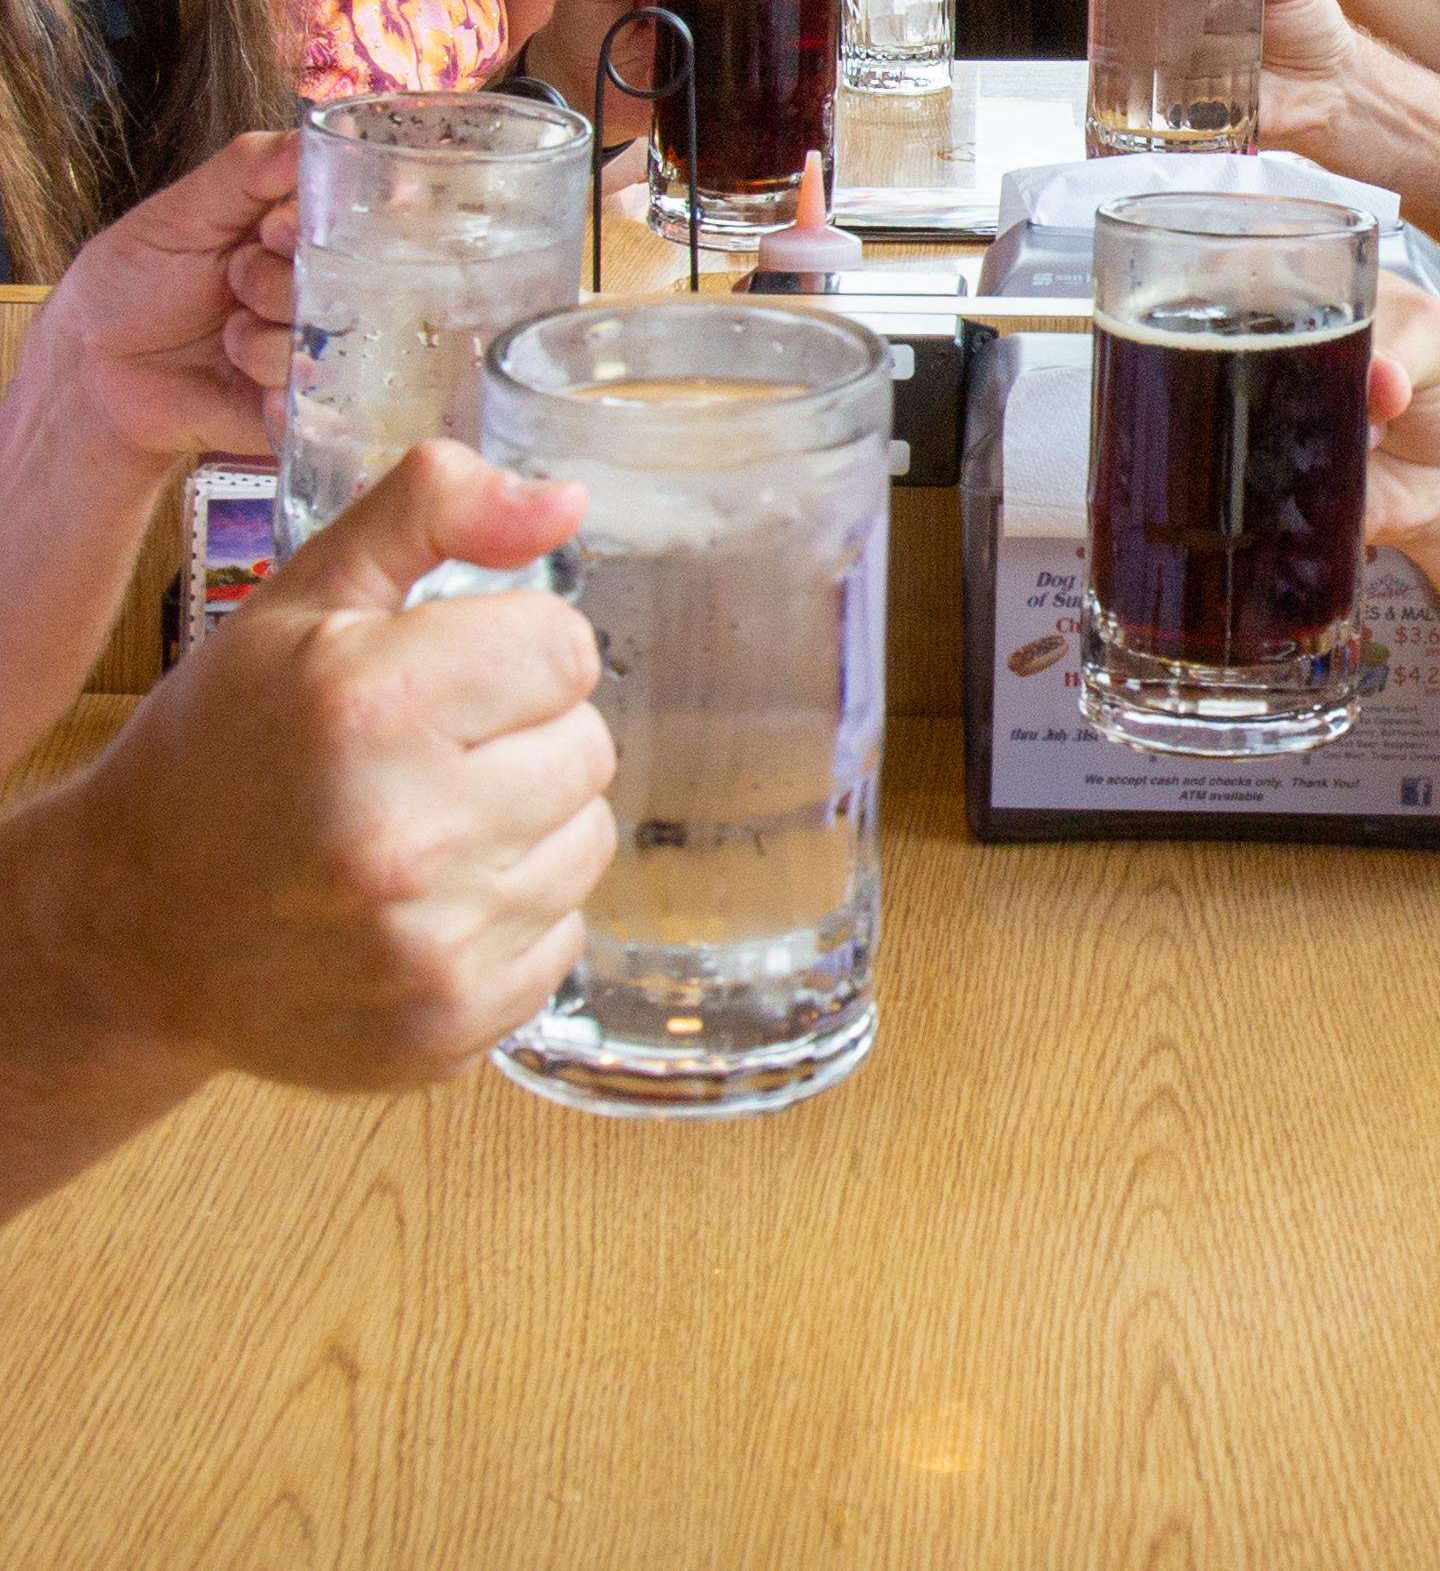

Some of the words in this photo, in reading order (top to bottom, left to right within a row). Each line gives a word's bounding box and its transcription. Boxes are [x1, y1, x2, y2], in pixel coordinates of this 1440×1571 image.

[1036, 572, 1075, 591] Dog
[1027, 594, 1047, 608] of
[1386, 606, 1396, 621] &
[1042, 728, 1068, 743] July
[1084, 773, 1104, 785] We
[1106, 775, 1148, 788] accept
[1150, 774, 1179, 786] cash
[1182, 774, 1206, 787] and
[1208, 775, 1252, 788] checks
[1291, 777, 1328, 789] Thank
[1333, 777, 1361, 789] You!
[1179, 790, 1206, 801] ATM
[1209, 790, 1265, 802] available
